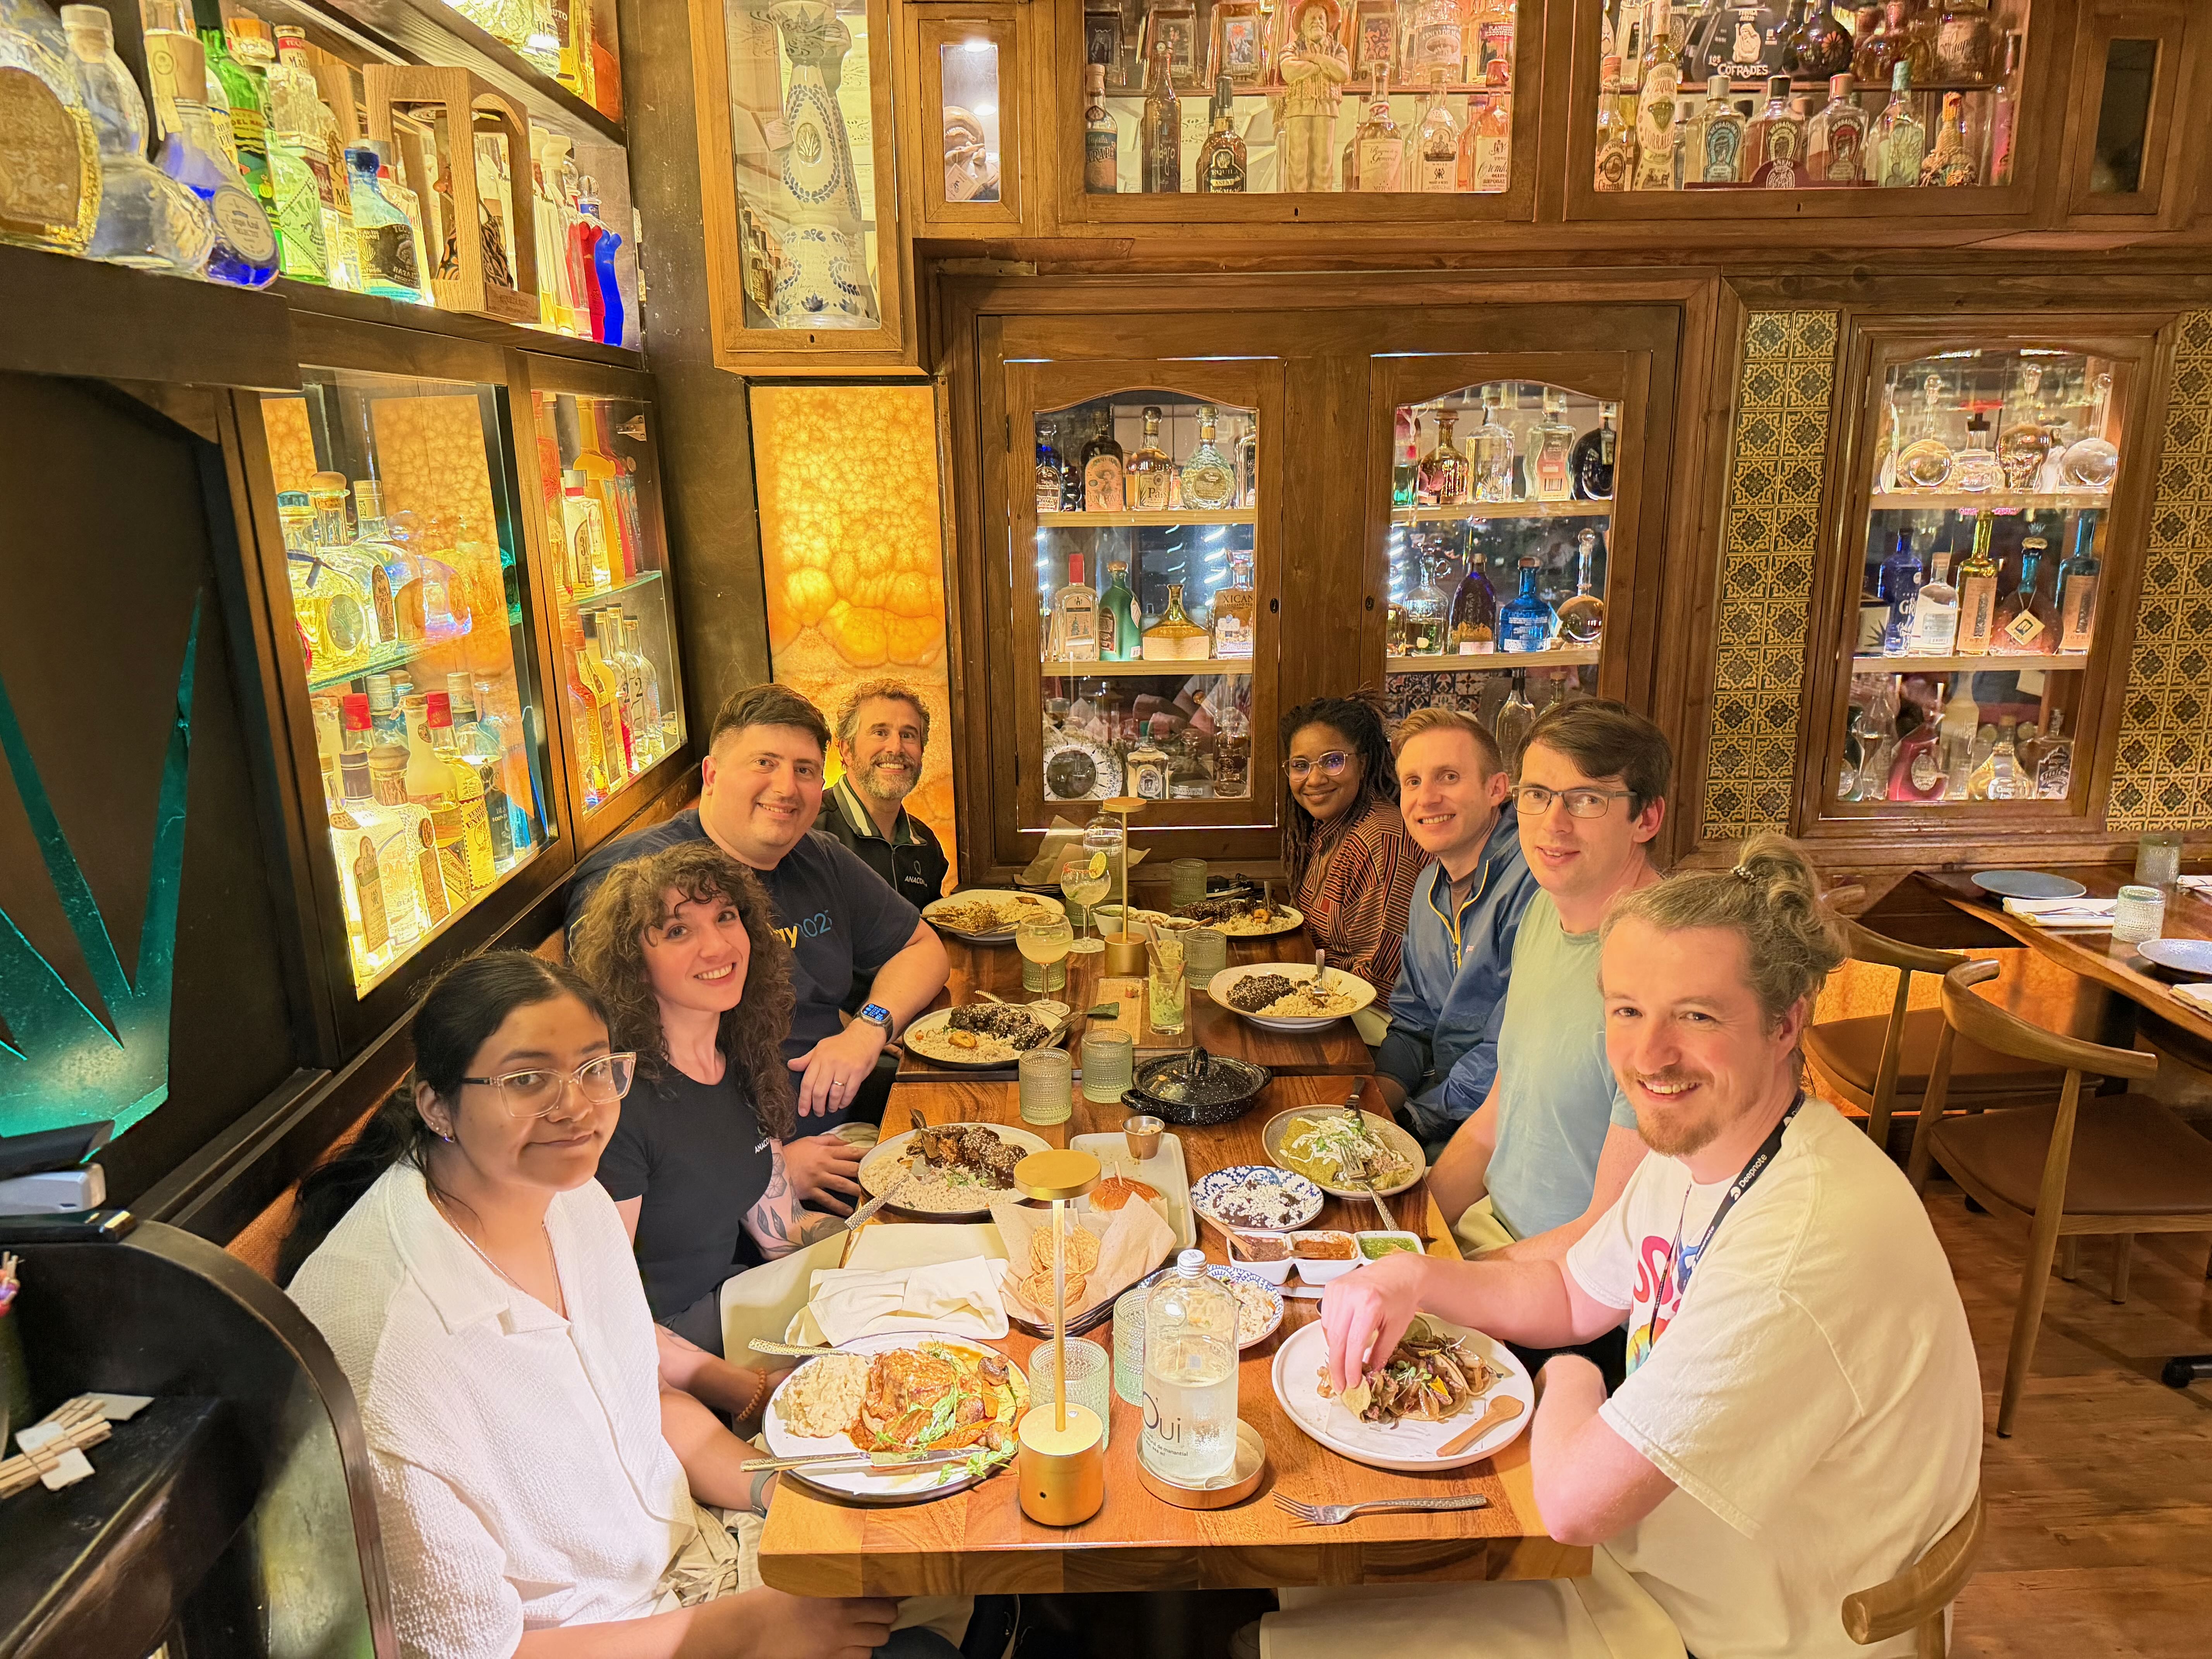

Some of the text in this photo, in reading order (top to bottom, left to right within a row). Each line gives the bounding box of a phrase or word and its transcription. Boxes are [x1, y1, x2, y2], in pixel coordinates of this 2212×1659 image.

[1717, 63, 1769, 79] COFRADES
[1738, 1154, 1767, 1188] Deepnote
[1163, 1447, 1188, 1456] manantial
